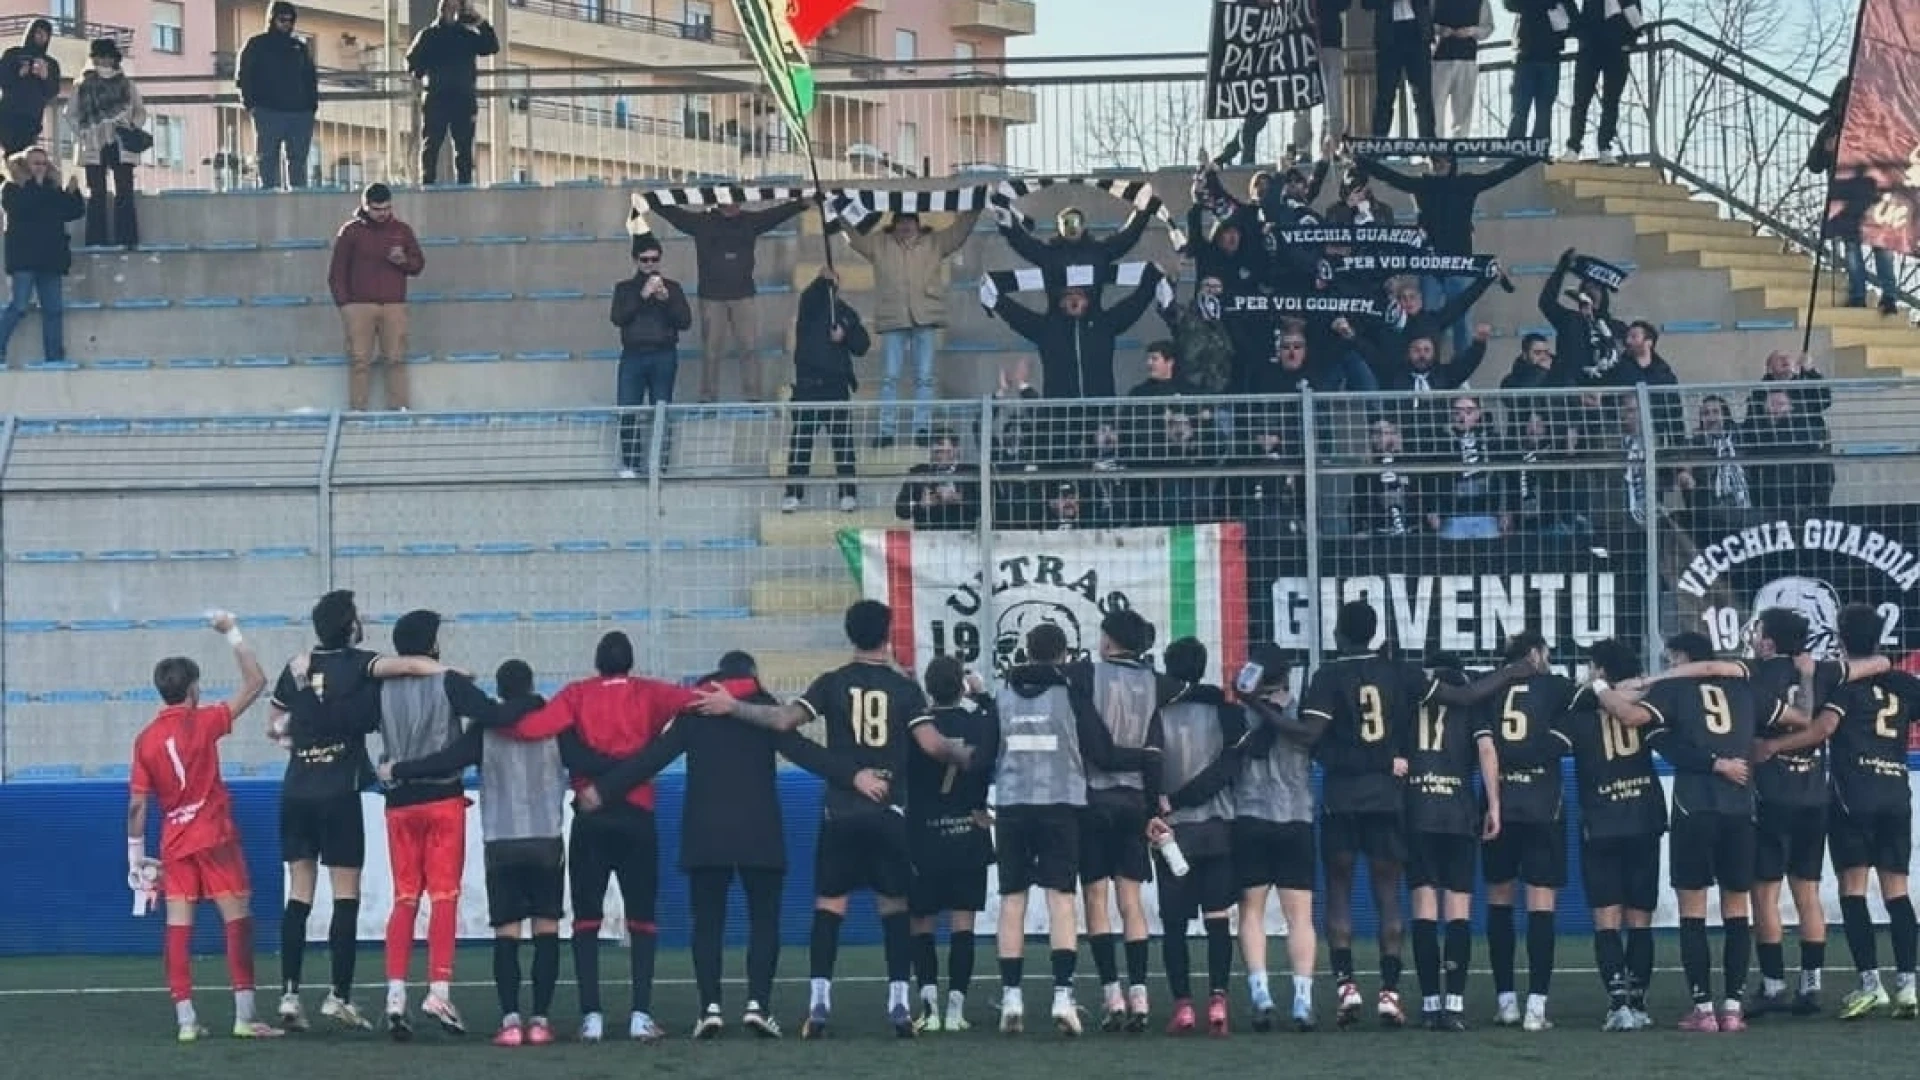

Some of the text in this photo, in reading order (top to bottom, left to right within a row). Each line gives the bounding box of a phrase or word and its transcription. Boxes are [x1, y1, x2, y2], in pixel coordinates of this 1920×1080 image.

[1221, 34, 1317, 78] PATRIA
[1282, 229, 1351, 244] VECCHIA
[1379, 256, 1406, 269] VOI
[1272, 297, 1301, 310] VOI
[1678, 518, 1920, 598] VECCHIA GUARDIA
[1702, 606, 1739, 651] 19
[849, 687, 888, 747] 18
[1360, 685, 1385, 742] 3
[1502, 684, 1529, 741] 5
[1700, 684, 1732, 734] 9
[1872, 685, 1898, 737] 2
[165, 737, 186, 791] 1
